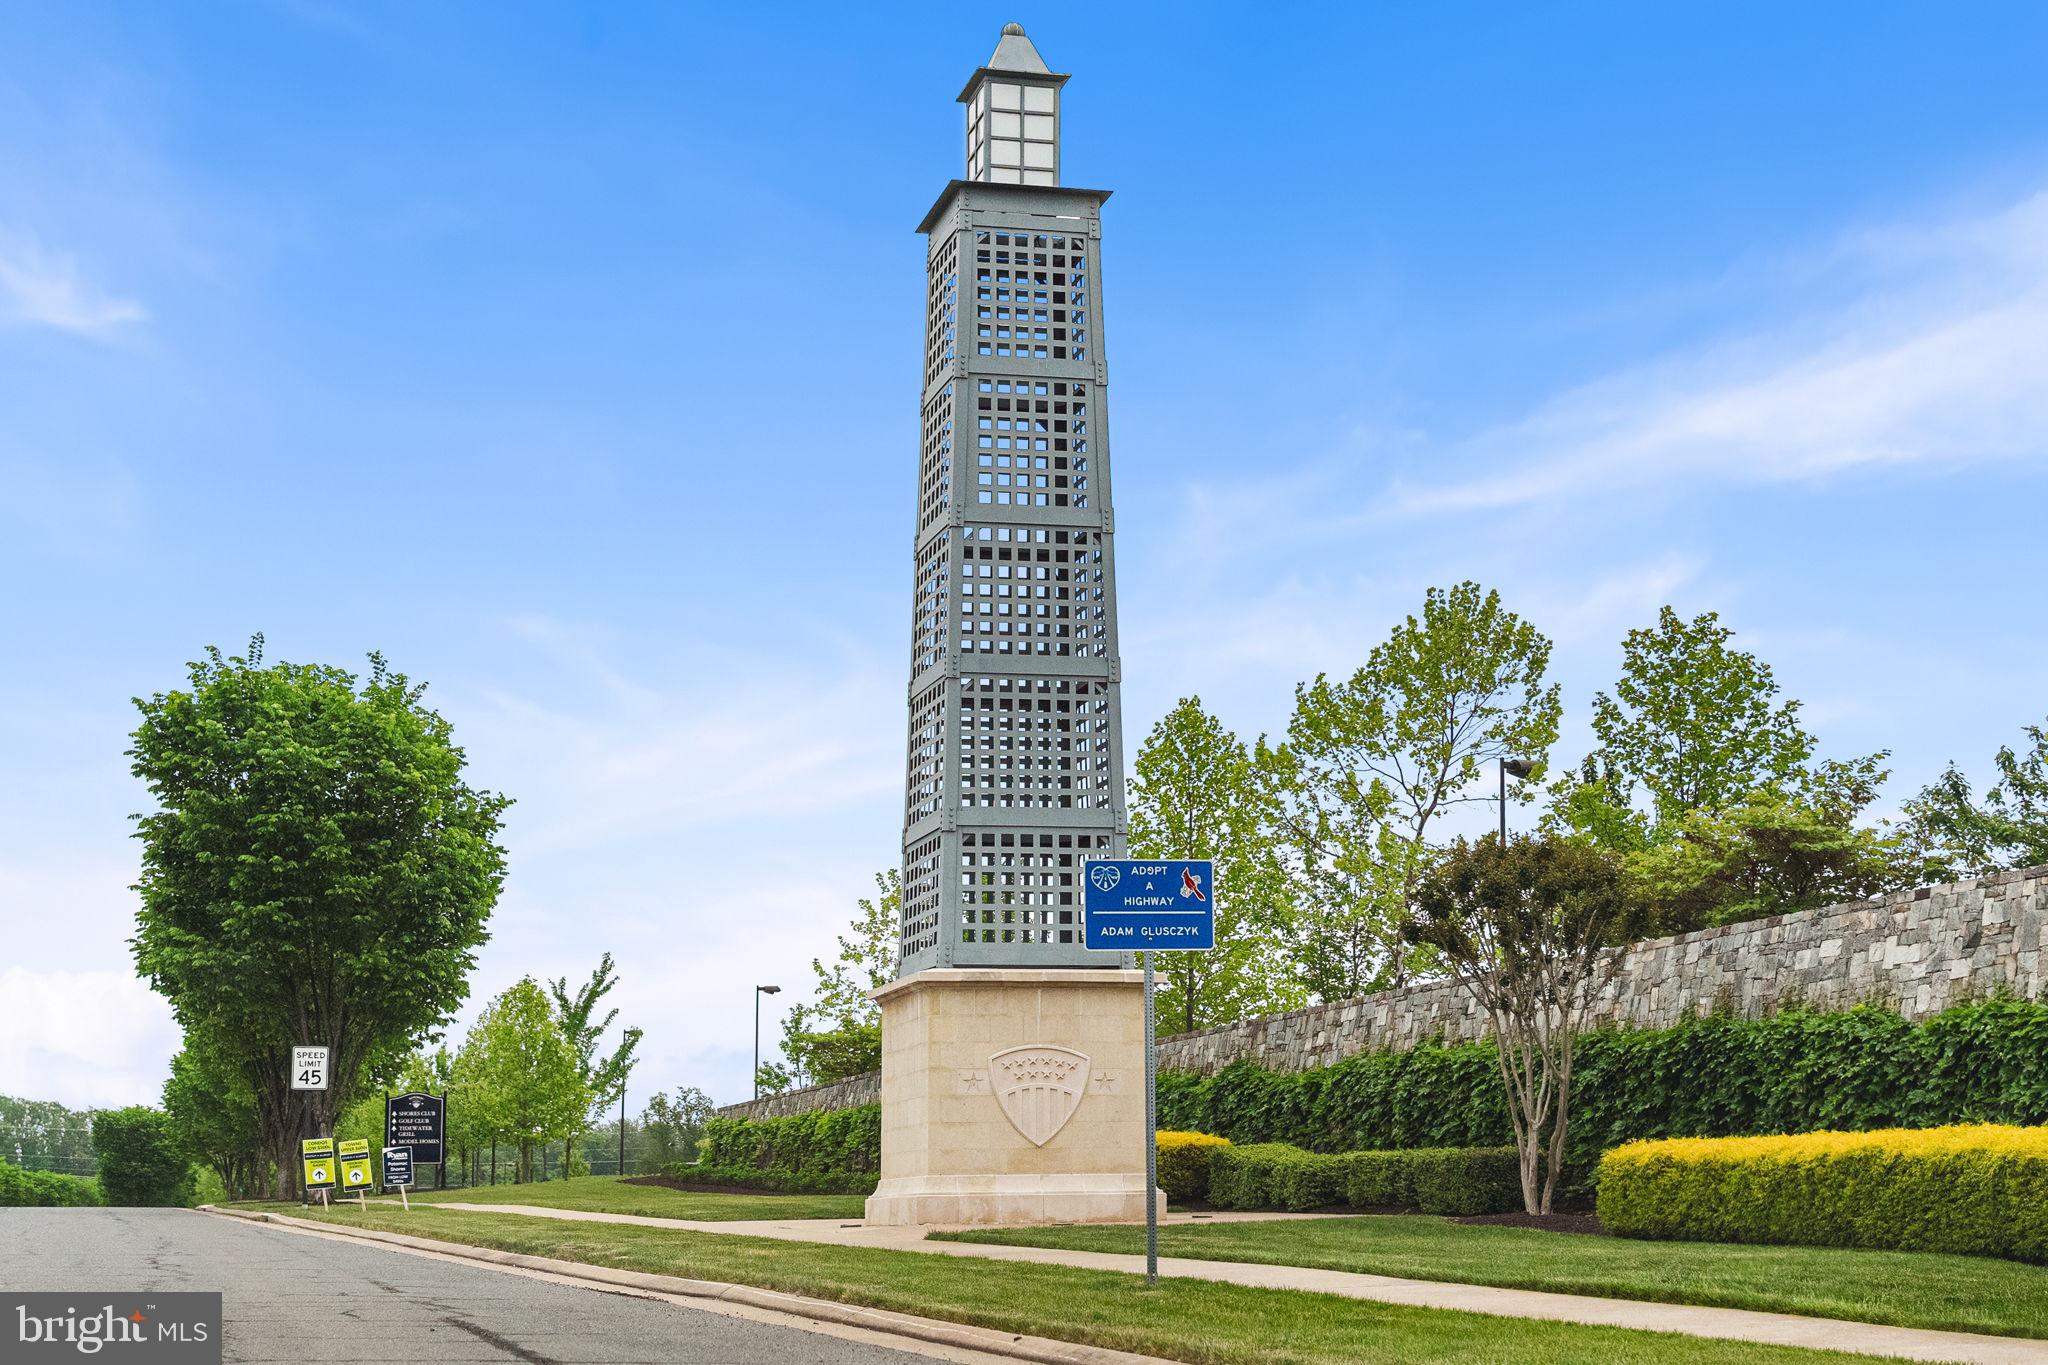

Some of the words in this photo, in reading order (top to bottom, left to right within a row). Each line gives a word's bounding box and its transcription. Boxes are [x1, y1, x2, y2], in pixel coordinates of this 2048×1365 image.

[1131, 866, 1168, 875] ADOPT
[1145, 881, 1154, 891] A
[1124, 896, 1175, 906] HIGHWAY
[1100, 926, 1134, 936] ADAM
[1140, 926, 1199, 936] GLUSCZYK
[296, 1051, 326, 1059] SPEED
[298, 1069, 322, 1085] 45
[386, 1151, 408, 1160] Ryan
